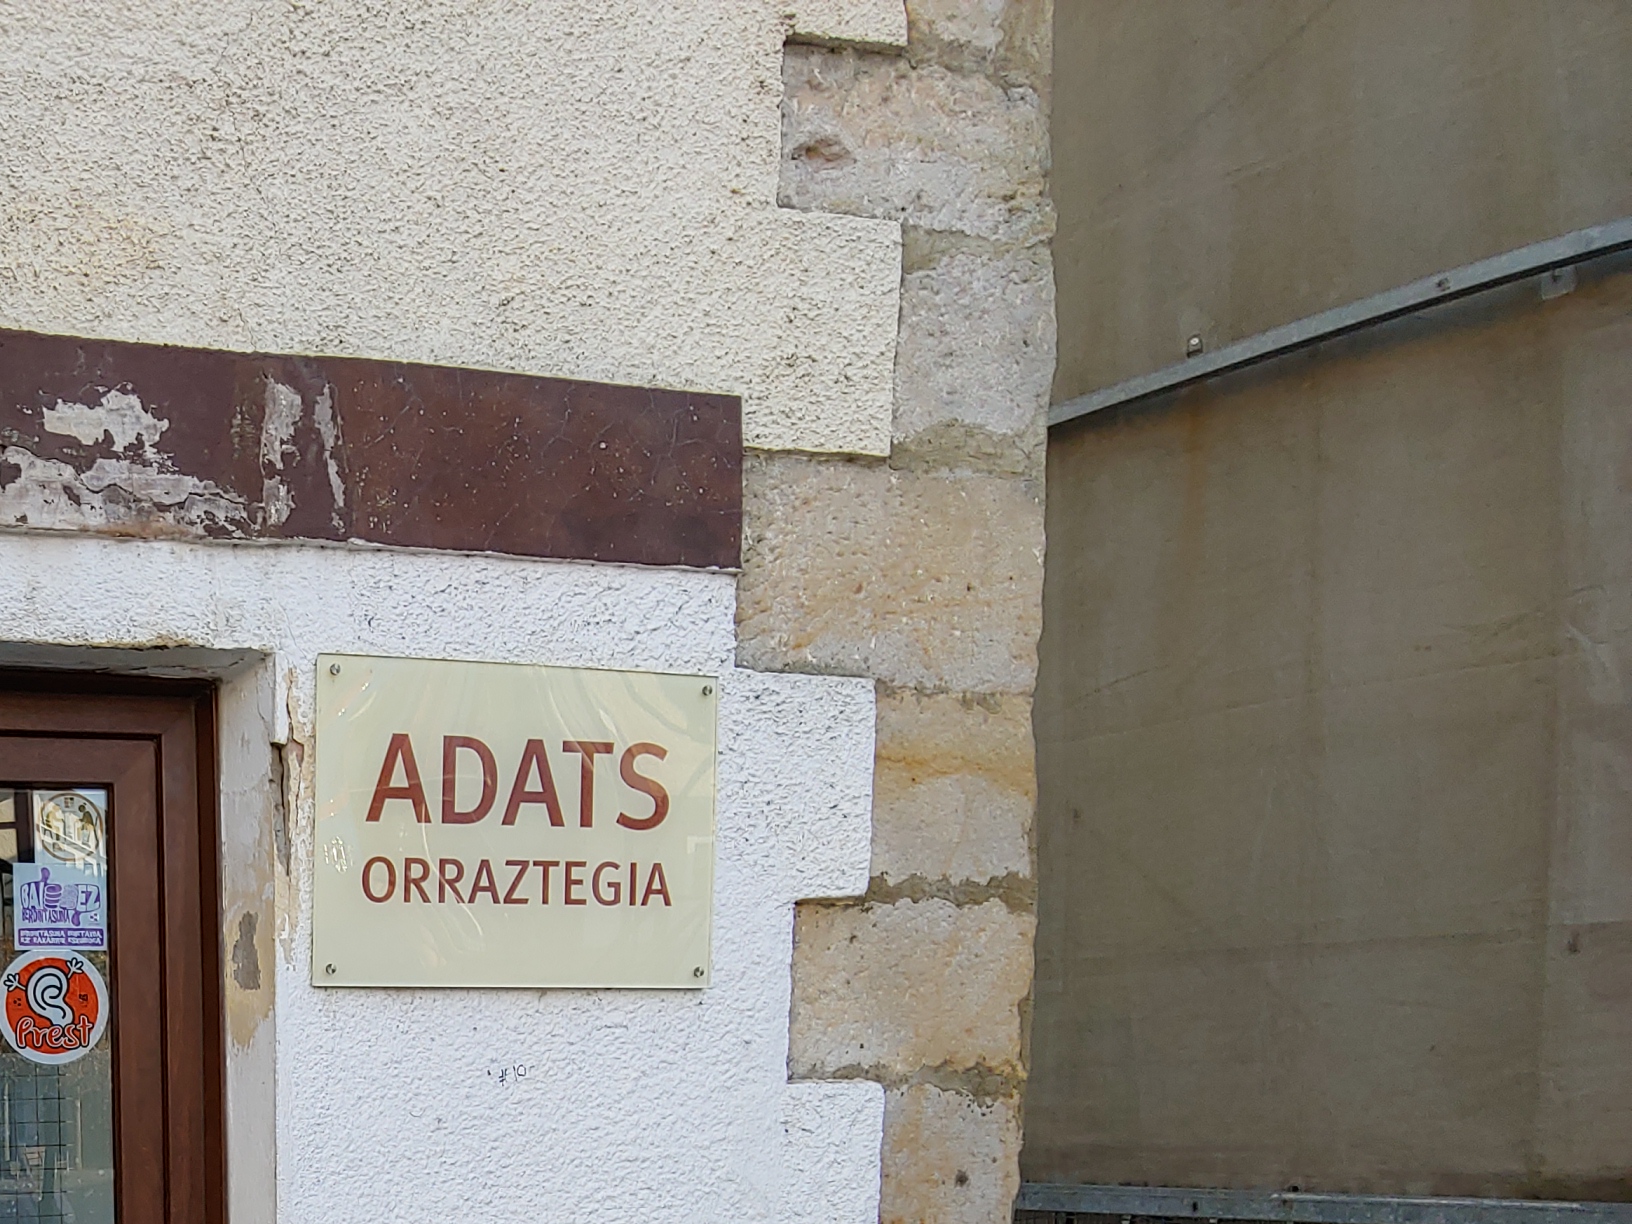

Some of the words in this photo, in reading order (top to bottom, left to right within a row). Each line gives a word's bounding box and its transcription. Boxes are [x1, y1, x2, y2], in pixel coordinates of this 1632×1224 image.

[365, 733, 670, 831] ADATS
[361, 856, 672, 907] ORRAZTEGIA
[16, 1015, 93, 1049] Prest
